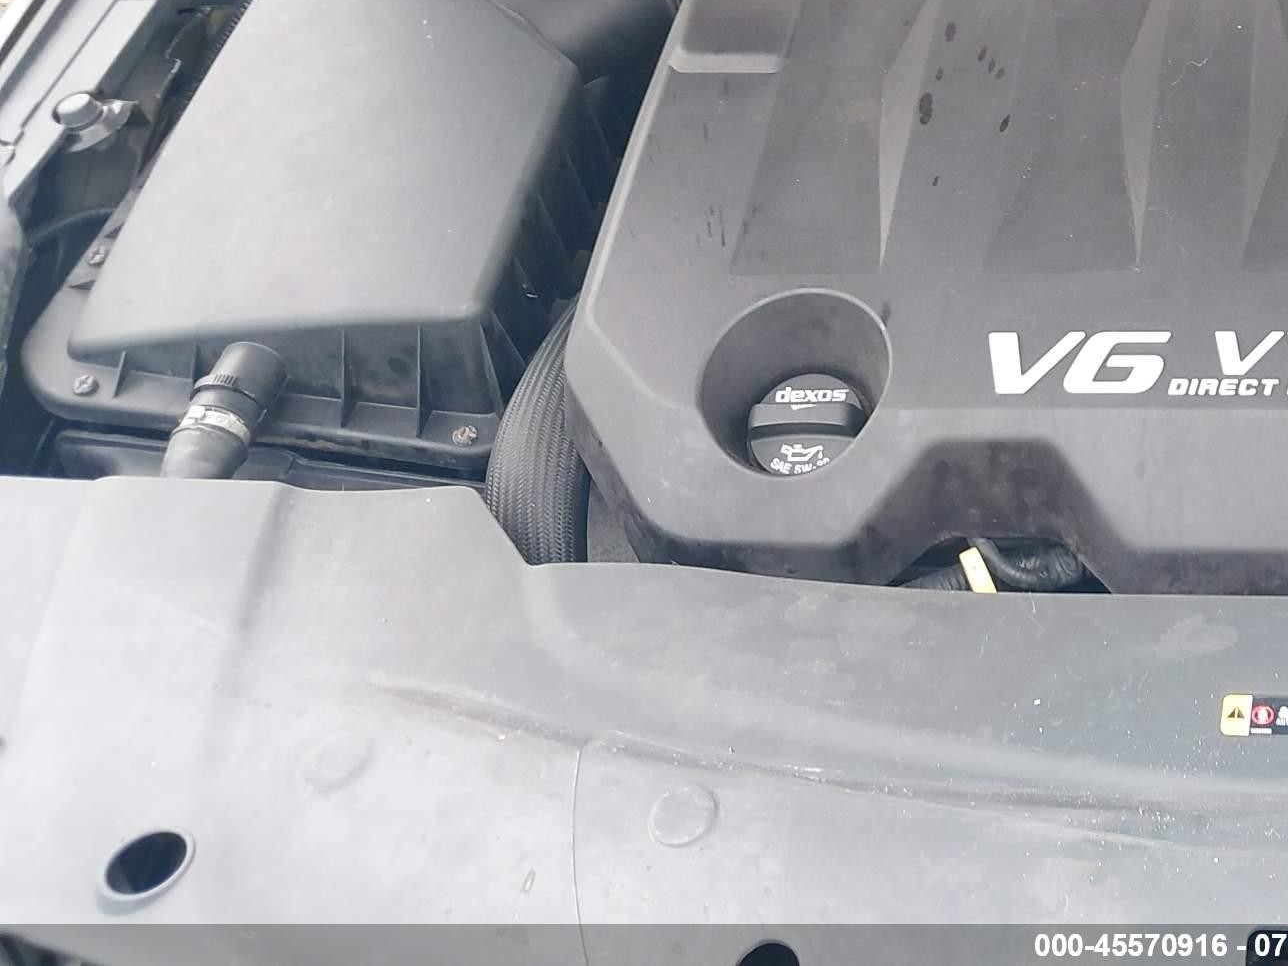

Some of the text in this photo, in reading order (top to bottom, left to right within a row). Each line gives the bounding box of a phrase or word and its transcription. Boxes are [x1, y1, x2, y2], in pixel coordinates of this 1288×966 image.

[988, 331, 1172, 395] V6
[775, 386, 850, 403] dexos
[1167, 378, 1280, 396] DIRECT
[770, 457, 792, 475] SAE
